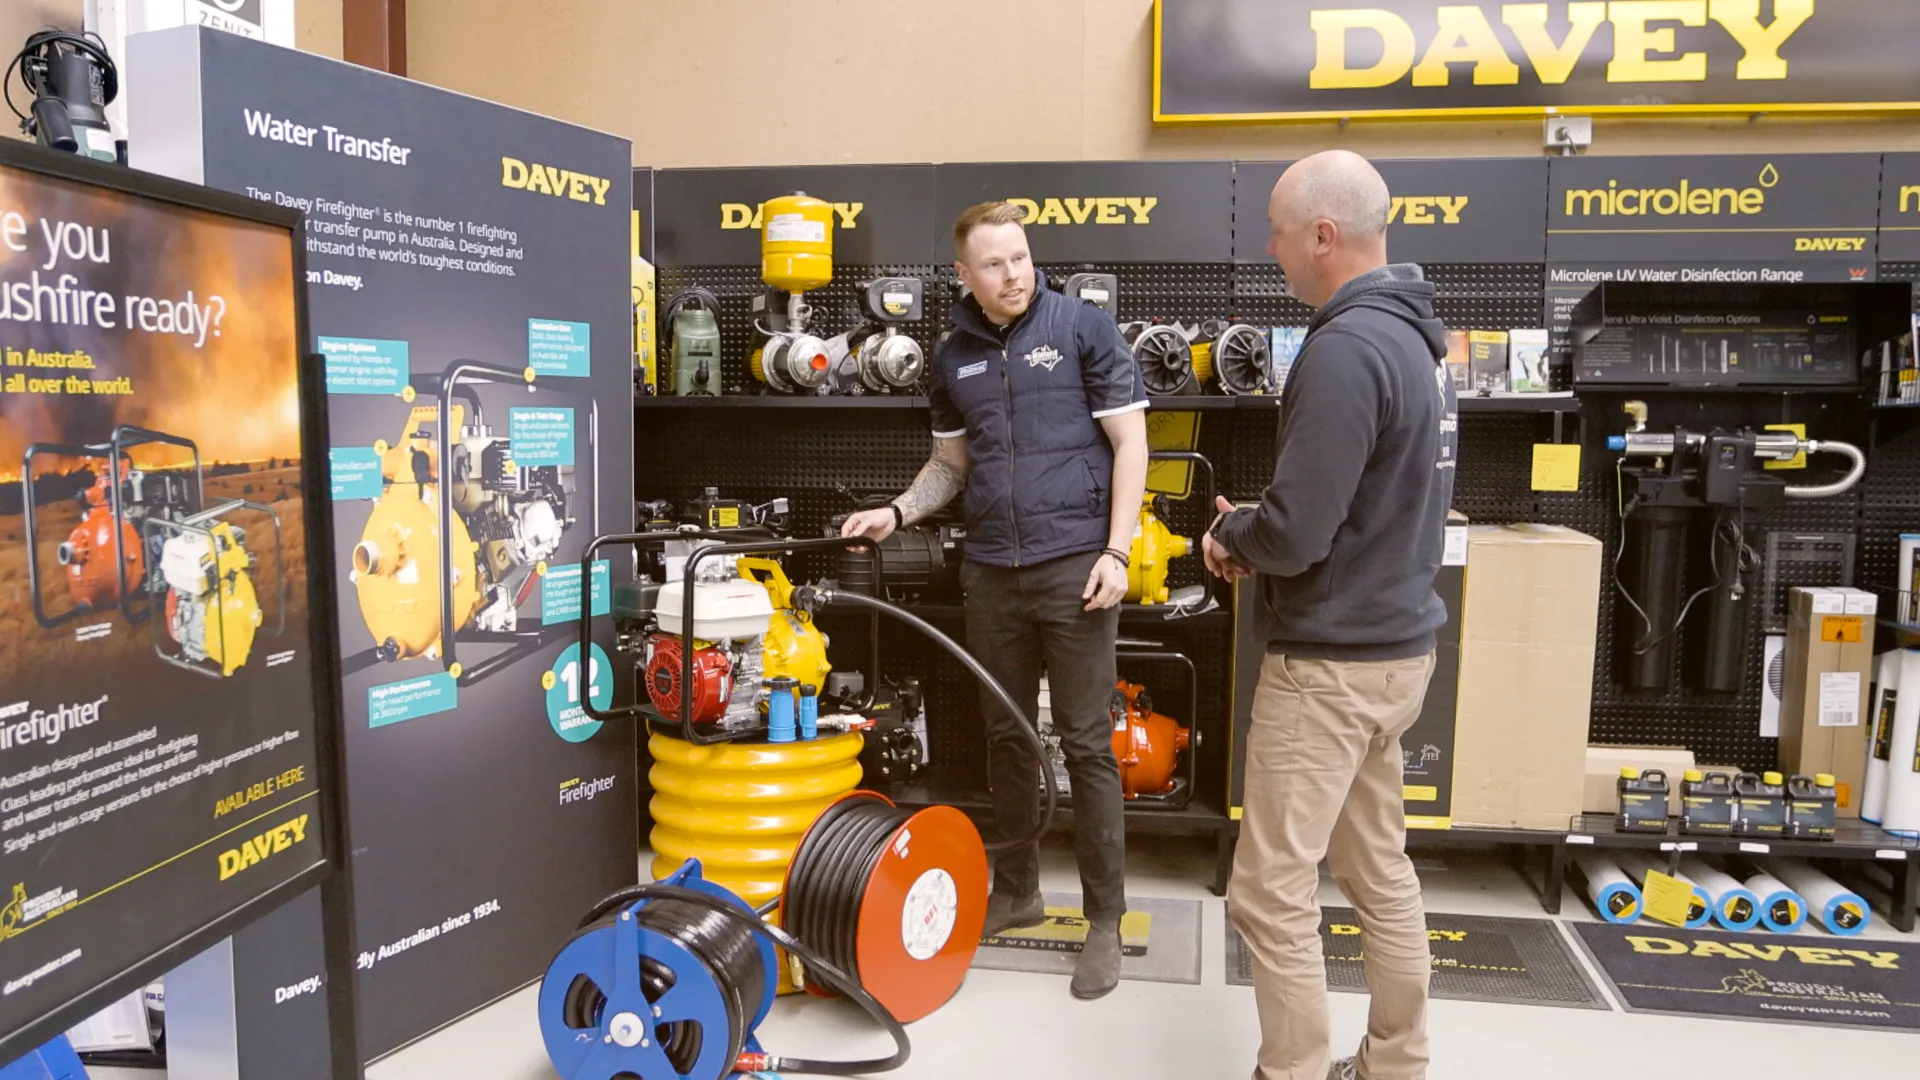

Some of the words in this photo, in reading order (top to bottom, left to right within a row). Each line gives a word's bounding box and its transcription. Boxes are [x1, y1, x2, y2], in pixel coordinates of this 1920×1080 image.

[1309, 0, 1815, 89] DAVEY
[244, 108, 317, 147] Water
[322, 125, 411, 166] Transfer
[502, 156, 611, 206] DAVEY
[1565, 179, 1764, 216] microlene
[246, 186, 271, 200] The
[275, 191, 313, 214] Davey
[383, 209, 392, 222] is
[395, 211, 413, 226] the
[415, 217, 456, 232] number
[458, 221, 464, 233] 1
[467, 221, 517, 245] firefighting
[1006, 197, 1158, 225] DAVEY
[40, 217, 110, 270] you
[314, 220, 360, 237] transfer
[363, 228, 396, 245] pump
[399, 230, 408, 244] in
[411, 232, 457, 251] Australia.
[459, 238, 503, 258] Designed
[506, 247, 523, 260] and
[1794, 237, 1866, 251] DAVEY
[323, 270, 363, 290] Davey.
[357, 245, 376, 259] the
[379, 249, 417, 265] world's
[419, 254, 464, 271] toughest
[466, 260, 516, 276] conditions.
[1551, 269, 1613, 282] Microlene
[1617, 269, 1638, 282] UV
[1639, 269, 1678, 282] Water
[1681, 267, 1757, 282] Disinfection
[1760, 268, 1804, 283] Range
[126, 290, 226, 348] ready?
[1625, 315, 1647, 324] Ultra
[1648, 315, 1672, 324] Violet
[1674, 315, 1724, 324] Disinfection
[1726, 315, 1761, 326] Options
[6, 347, 23, 366] in
[26, 348, 96, 369] Australia.
[6, 373, 25, 393] all
[28, 378, 62, 393] over
[66, 375, 90, 394] the
[92, 376, 134, 395] world.
[0, 765, 51, 790] Australian
[51, 748, 94, 770] designed
[95, 741, 112, 757] and
[113, 726, 157, 751] assembled
[0, 795, 29, 812] Class
[30, 781, 66, 802] leading
[67, 761, 123, 792] performance
[124, 751, 144, 767] ideal
[145, 748, 156, 760] for
[157, 734, 198, 756] firefighting
[2, 812, 24, 831] and
[24, 803, 52, 822] water
[54, 789, 90, 811] transfer
[91, 775, 124, 798] around
[124, 771, 138, 785] the
[139, 762, 163, 779] home
[164, 754, 179, 770] and
[179, 749, 198, 763] farm
[3, 833, 36, 854] Single
[37, 822, 57, 841] and
[57, 816, 79, 833] twin
[79, 806, 105, 824] stage
[106, 791, 141, 813] versions
[141, 785, 153, 798] for
[154, 781, 168, 793] the
[168, 771, 192, 788] choice
[193, 765, 200, 778] of
[200, 756, 223, 775] higher
[224, 746, 254, 768] pressure
[262, 734, 284, 751] higher
[213, 777, 275, 819] AVAILABLE
[276, 765, 305, 790] HERE
[559, 775, 615, 805] Firefighter
[218, 814, 309, 881] DAVEY
[378, 925, 440, 961] Australian
[441, 912, 470, 934] since
[473, 898, 501, 920] 1934.
[1624, 935, 1899, 970] DAVEY
[274, 975, 322, 1004] Davey.
[1760, 1003, 1891, 1018] daveywater.com
